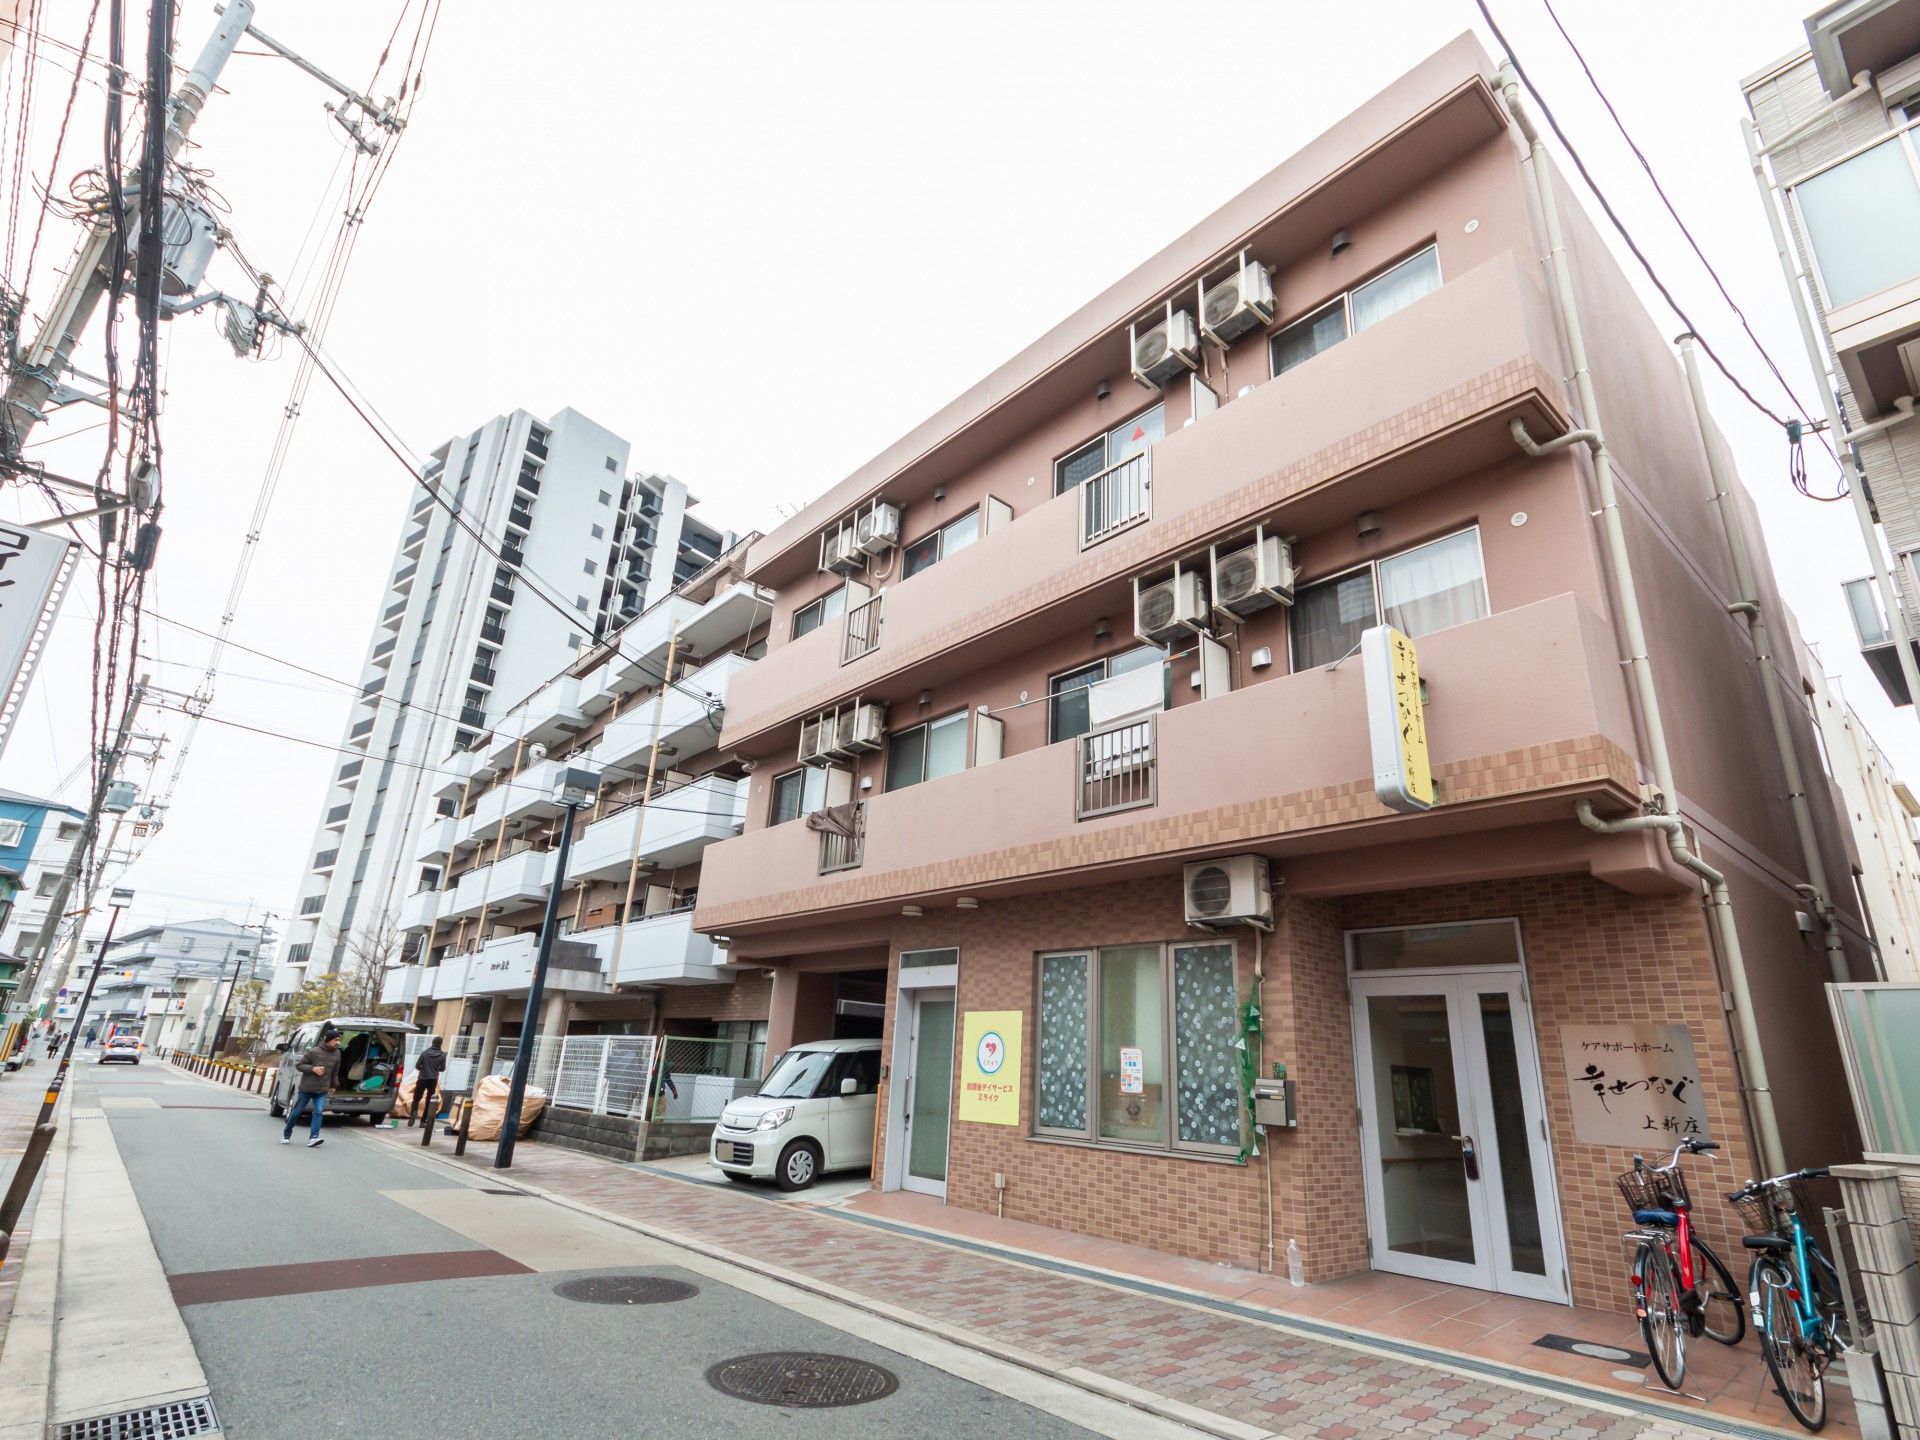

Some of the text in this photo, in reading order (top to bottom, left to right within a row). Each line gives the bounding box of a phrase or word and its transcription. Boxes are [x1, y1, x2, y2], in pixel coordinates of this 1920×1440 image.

[1581, 1041, 1674, 1054] ケアサポートホーム
[1573, 1062, 1694, 1115] 幸せつなぐ
[977, 1093, 999, 1102] ミライク
[1642, 1115, 1702, 1135] 上新庄
